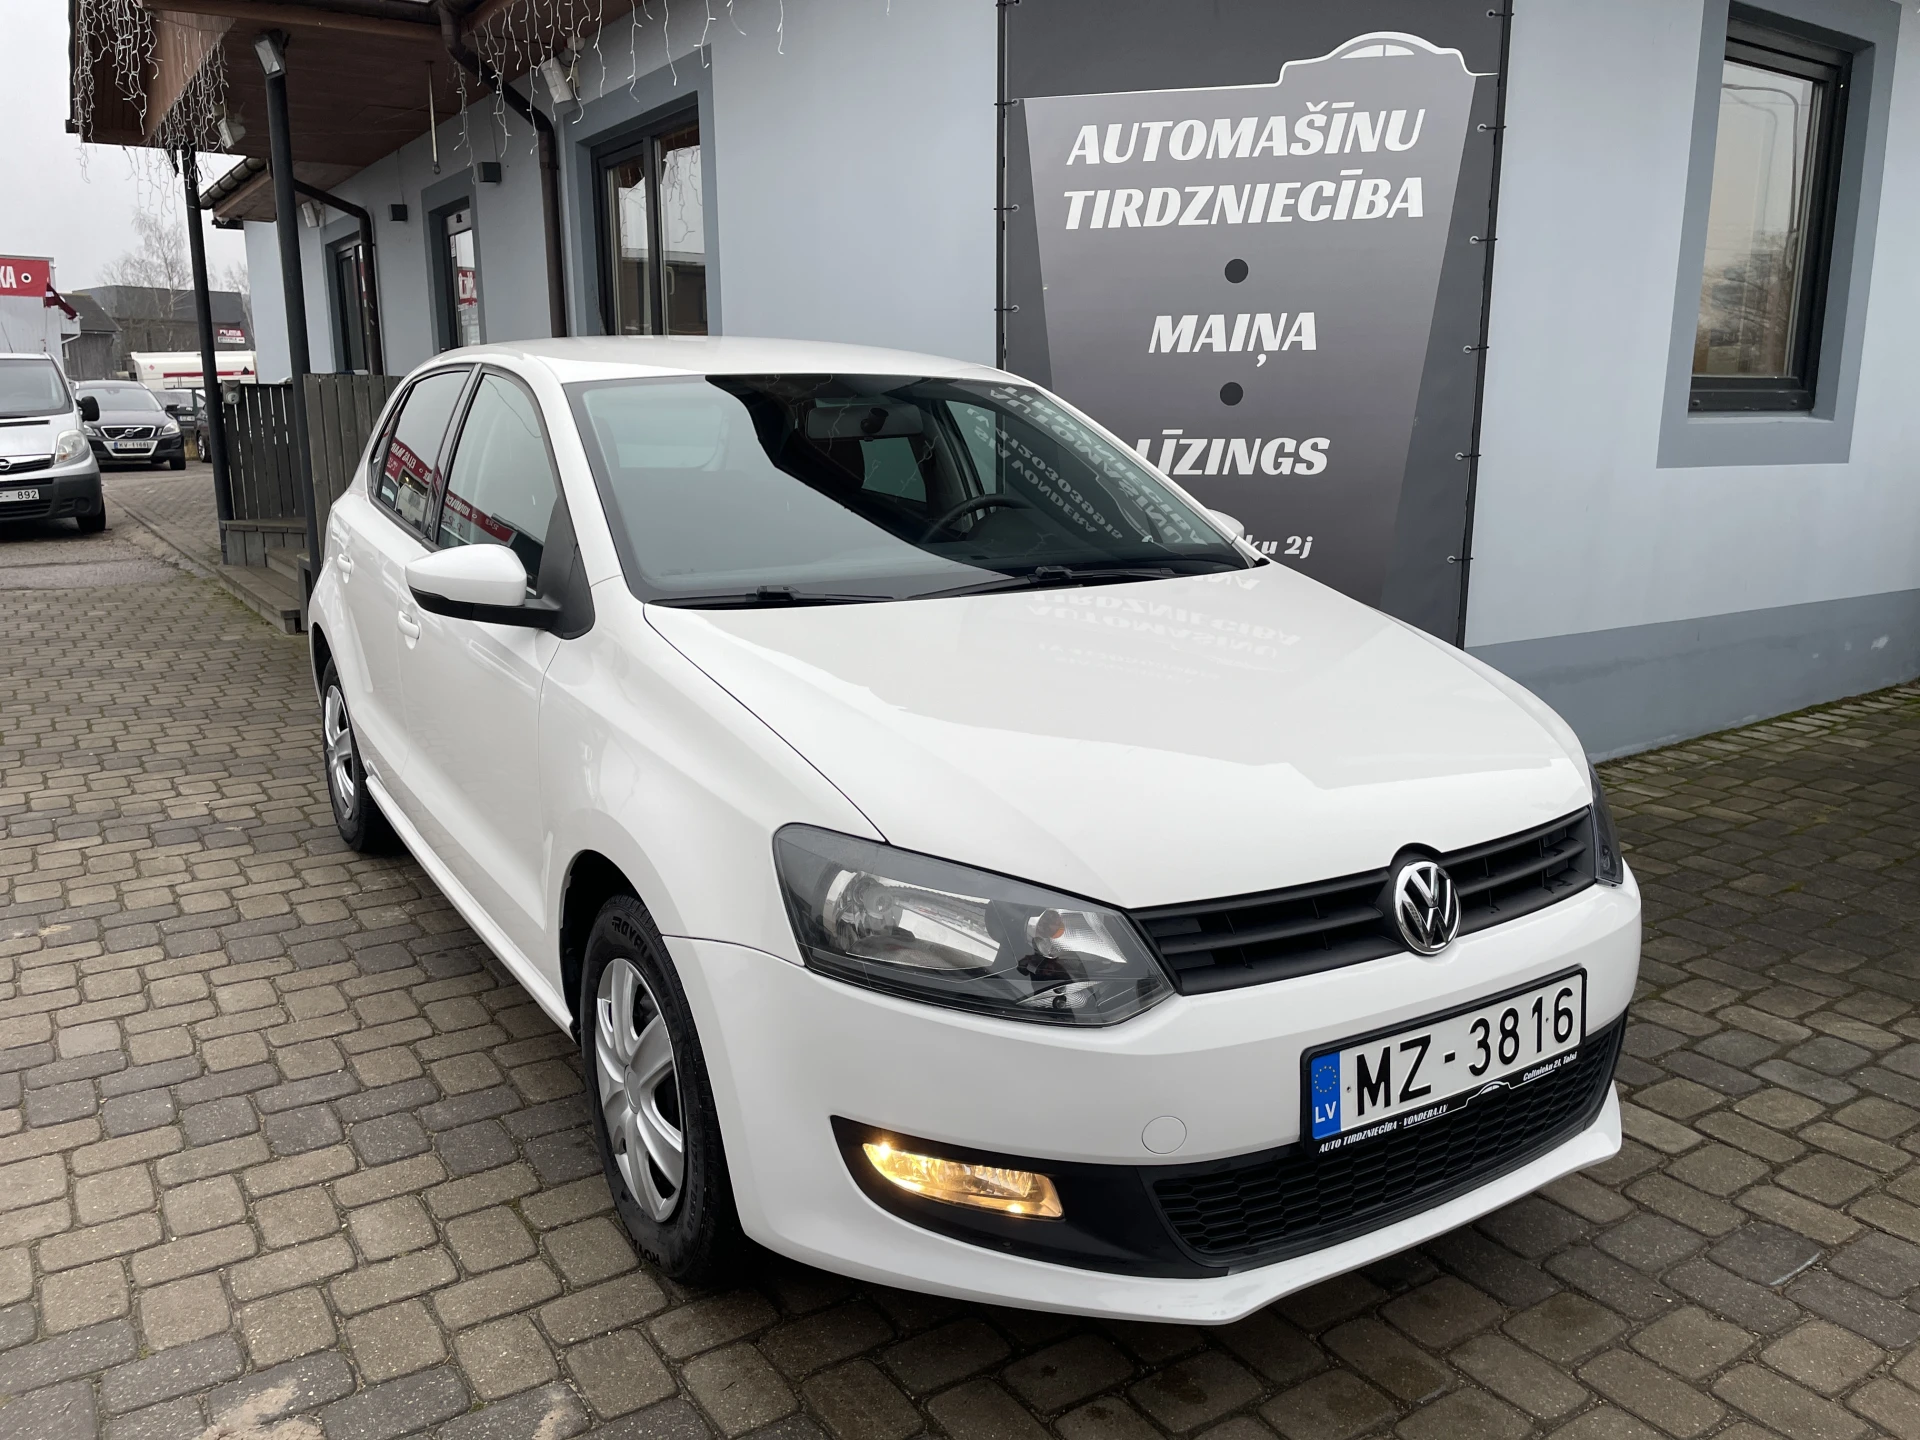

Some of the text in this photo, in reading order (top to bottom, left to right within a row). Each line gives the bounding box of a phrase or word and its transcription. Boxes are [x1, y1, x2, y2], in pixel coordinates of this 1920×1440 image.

[1066, 101, 1426, 166] AUTOMAŠĪNU
[1063, 169, 1425, 230] TIRDZNIECĪBA
[1148, 311, 1318, 368] MAIŅA
[1284, 535, 1313, 559] 2j
[1314, 1100, 1337, 1124] LV
[1318, 1138, 1342, 1154] AUTO
[1342, 1120, 1398, 1146] TIRDZNIECĪBA
[1403, 1103, 1449, 1127] VONDERA.LV
